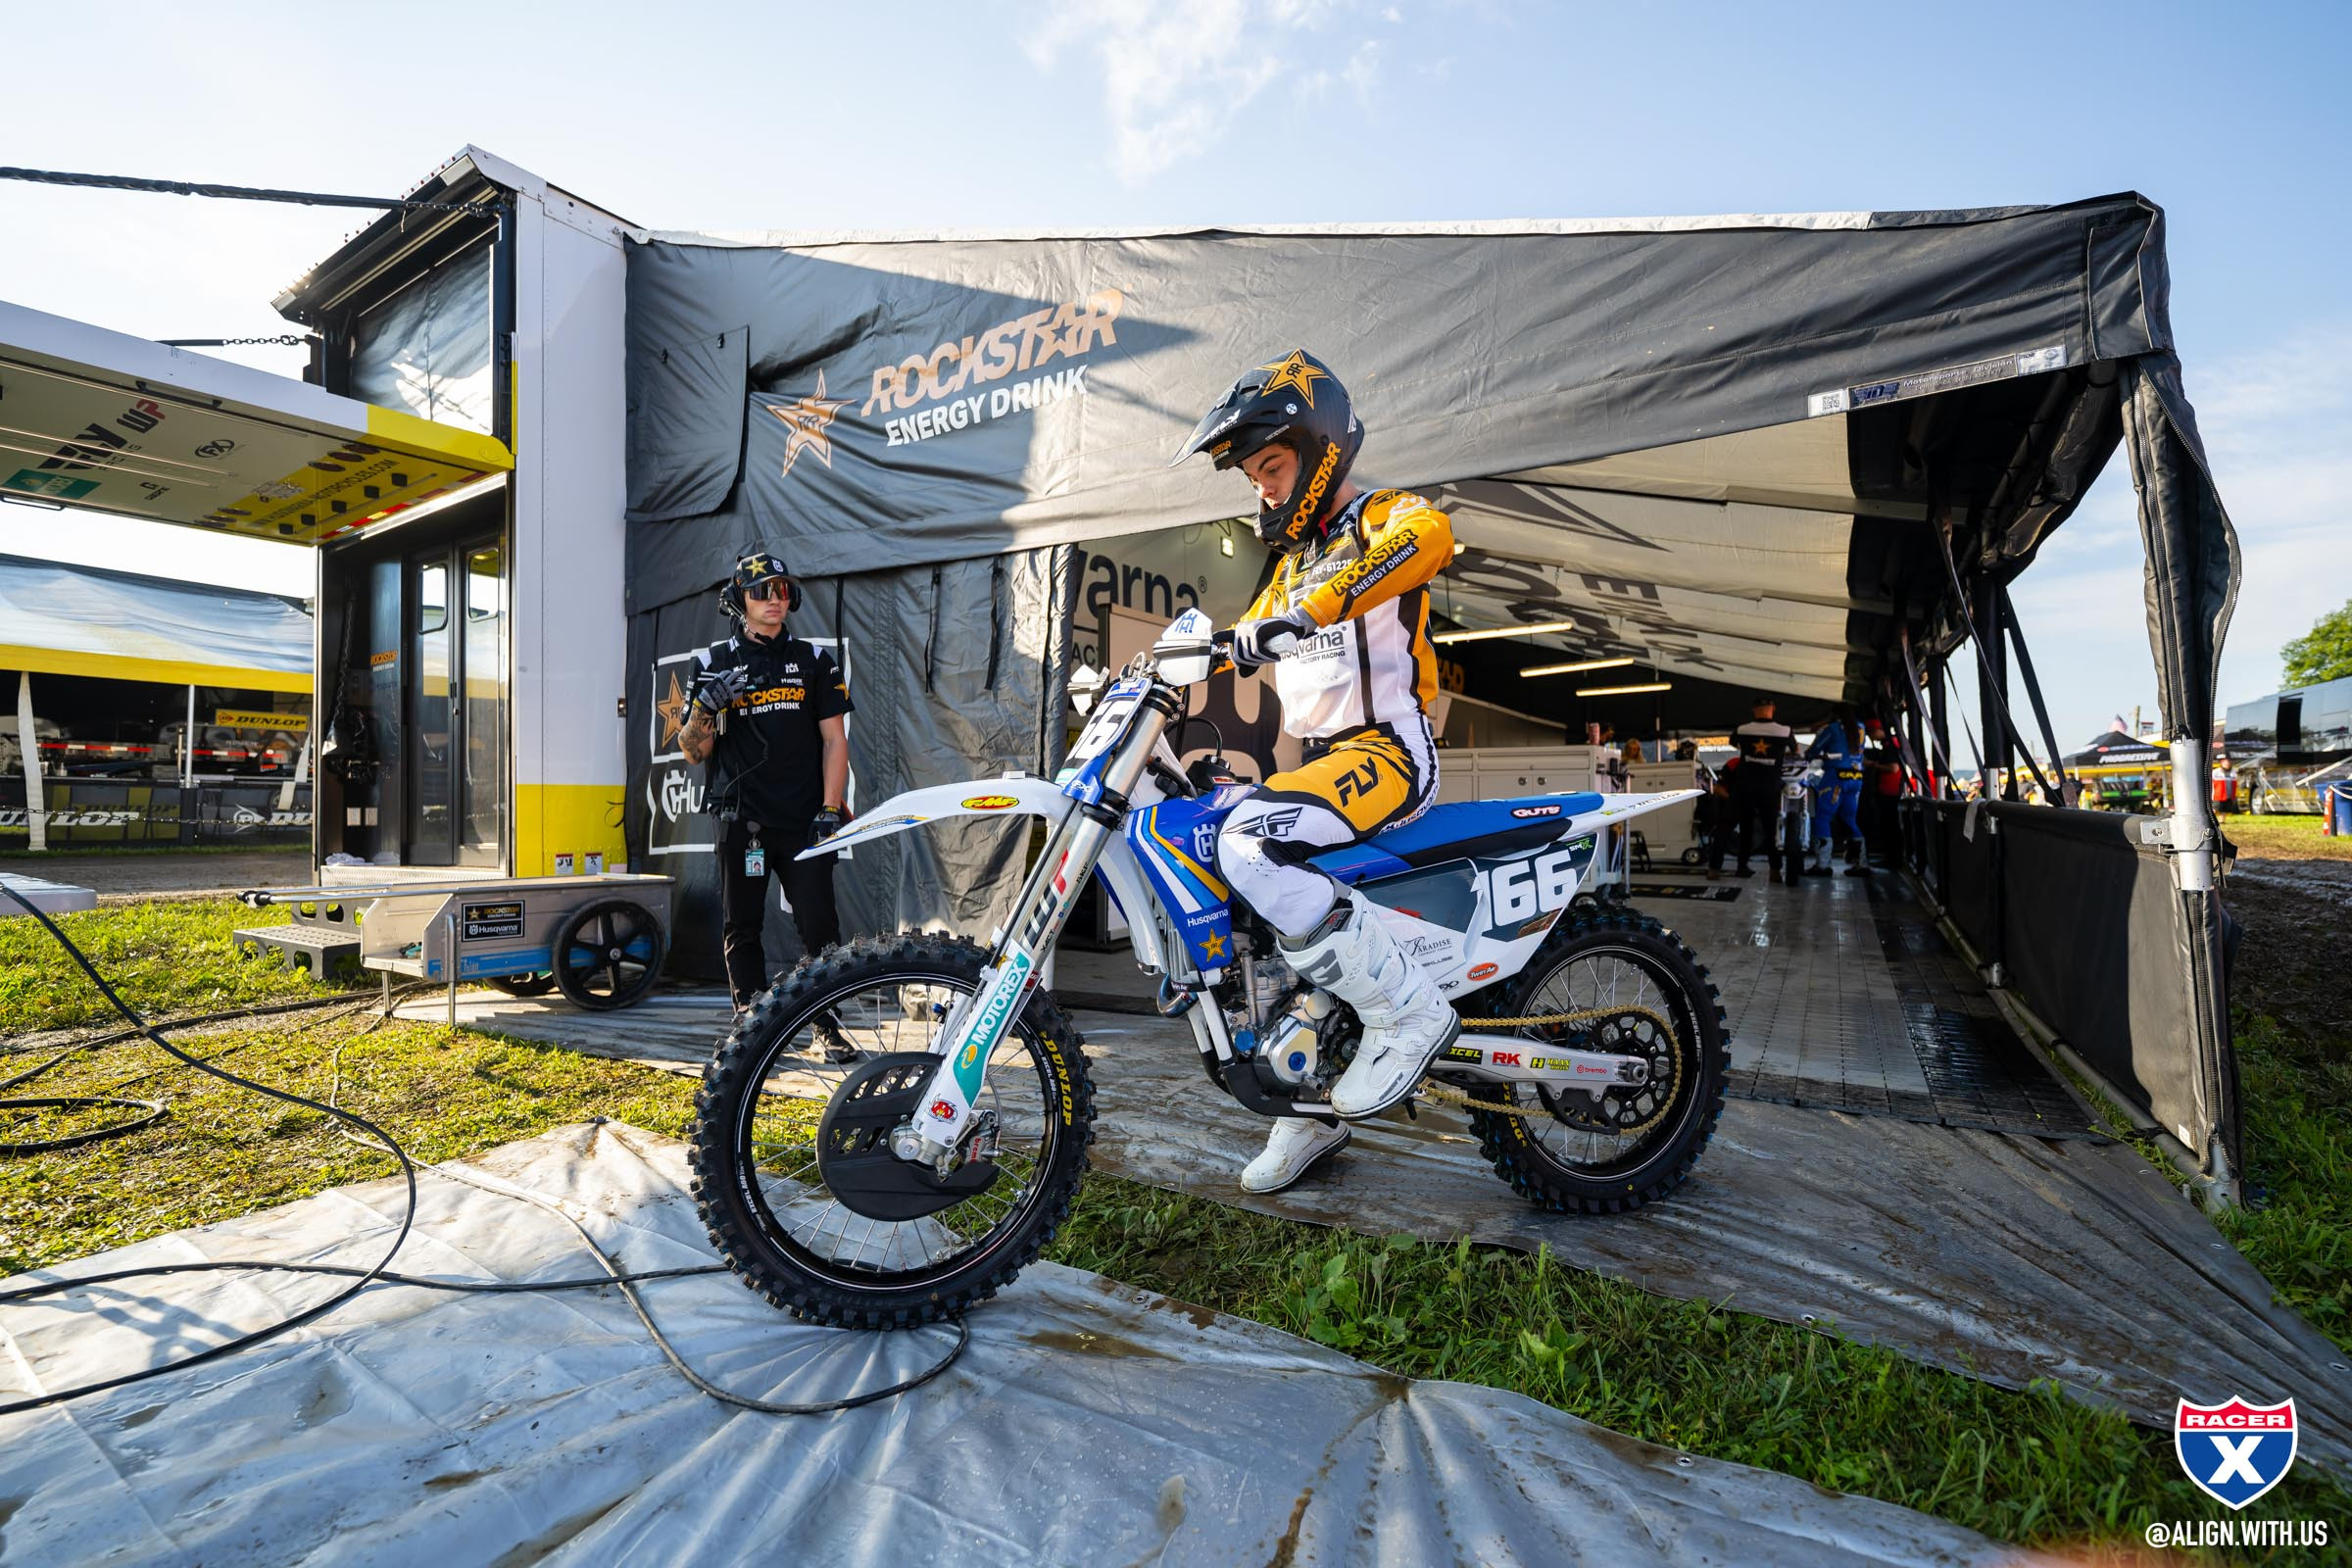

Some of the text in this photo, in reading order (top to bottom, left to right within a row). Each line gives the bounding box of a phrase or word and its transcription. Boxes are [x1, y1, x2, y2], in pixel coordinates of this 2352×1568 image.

[860, 288, 1123, 416] ROCKSTAR
[886, 365, 1088, 447] ENERGY DRINK
[1286, 442, 1342, 540] ROCKSTAR
[1332, 529, 1419, 597] ROCKSTAR
[1350, 566, 1388, 598] ENERGY
[1387, 544, 1417, 572] DRINK
[1321, 651, 1346, 661] RACING
[773, 702, 801, 710] DRINK
[236, 715, 306, 727] DUNLOP
[1334, 757, 1379, 808] FLY
[962, 796, 1018, 809] FMF
[1513, 806, 1560, 817] GUTS
[1472, 849, 1579, 934] 166
[484, 906, 519, 915] ROCKSTAR
[1187, 907, 1228, 928] Husqvarna
[479, 924, 518, 934] Husqvarna
[1470, 964, 1496, 980] Twin Air
[970, 960, 1027, 1046] MOTOREX
[1493, 1052, 1521, 1065] RK
[1584, 1066, 1608, 1075] brembo
[1044, 1039, 1073, 1126] DUNLOP
